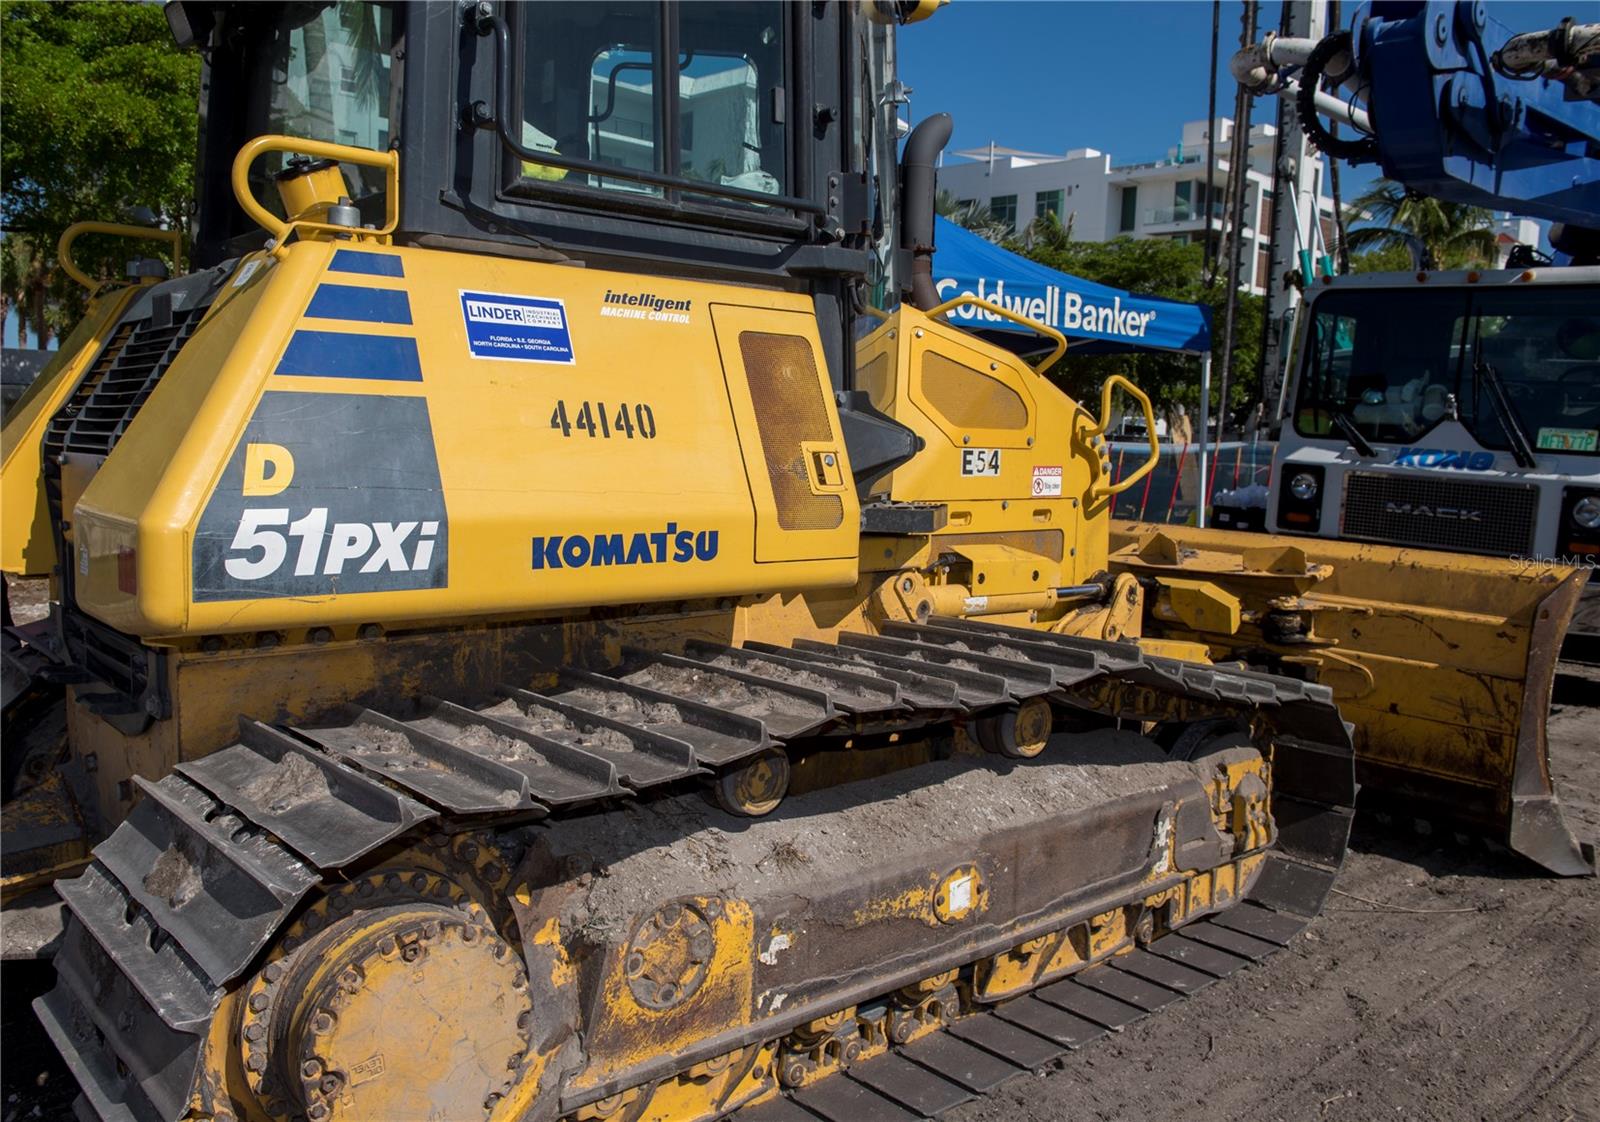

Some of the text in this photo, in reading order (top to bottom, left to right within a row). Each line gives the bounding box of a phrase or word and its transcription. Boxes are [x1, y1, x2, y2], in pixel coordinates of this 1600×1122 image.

[604, 289, 691, 311] intelligent
[936, 278, 1060, 326] Coldwell
[469, 305, 523, 321] LINDER
[600, 306, 690, 324] MACHINE CONTROL
[543, 345, 569, 353] CAROLINA
[550, 400, 656, 439] 44140
[242, 443, 295, 496] D
[962, 450, 999, 475] E54
[1039, 467, 1062, 475] DANGER
[1385, 502, 1481, 520] MACK
[224, 508, 440, 580] 51PXi
[532, 522, 719, 570] KOMATSU
